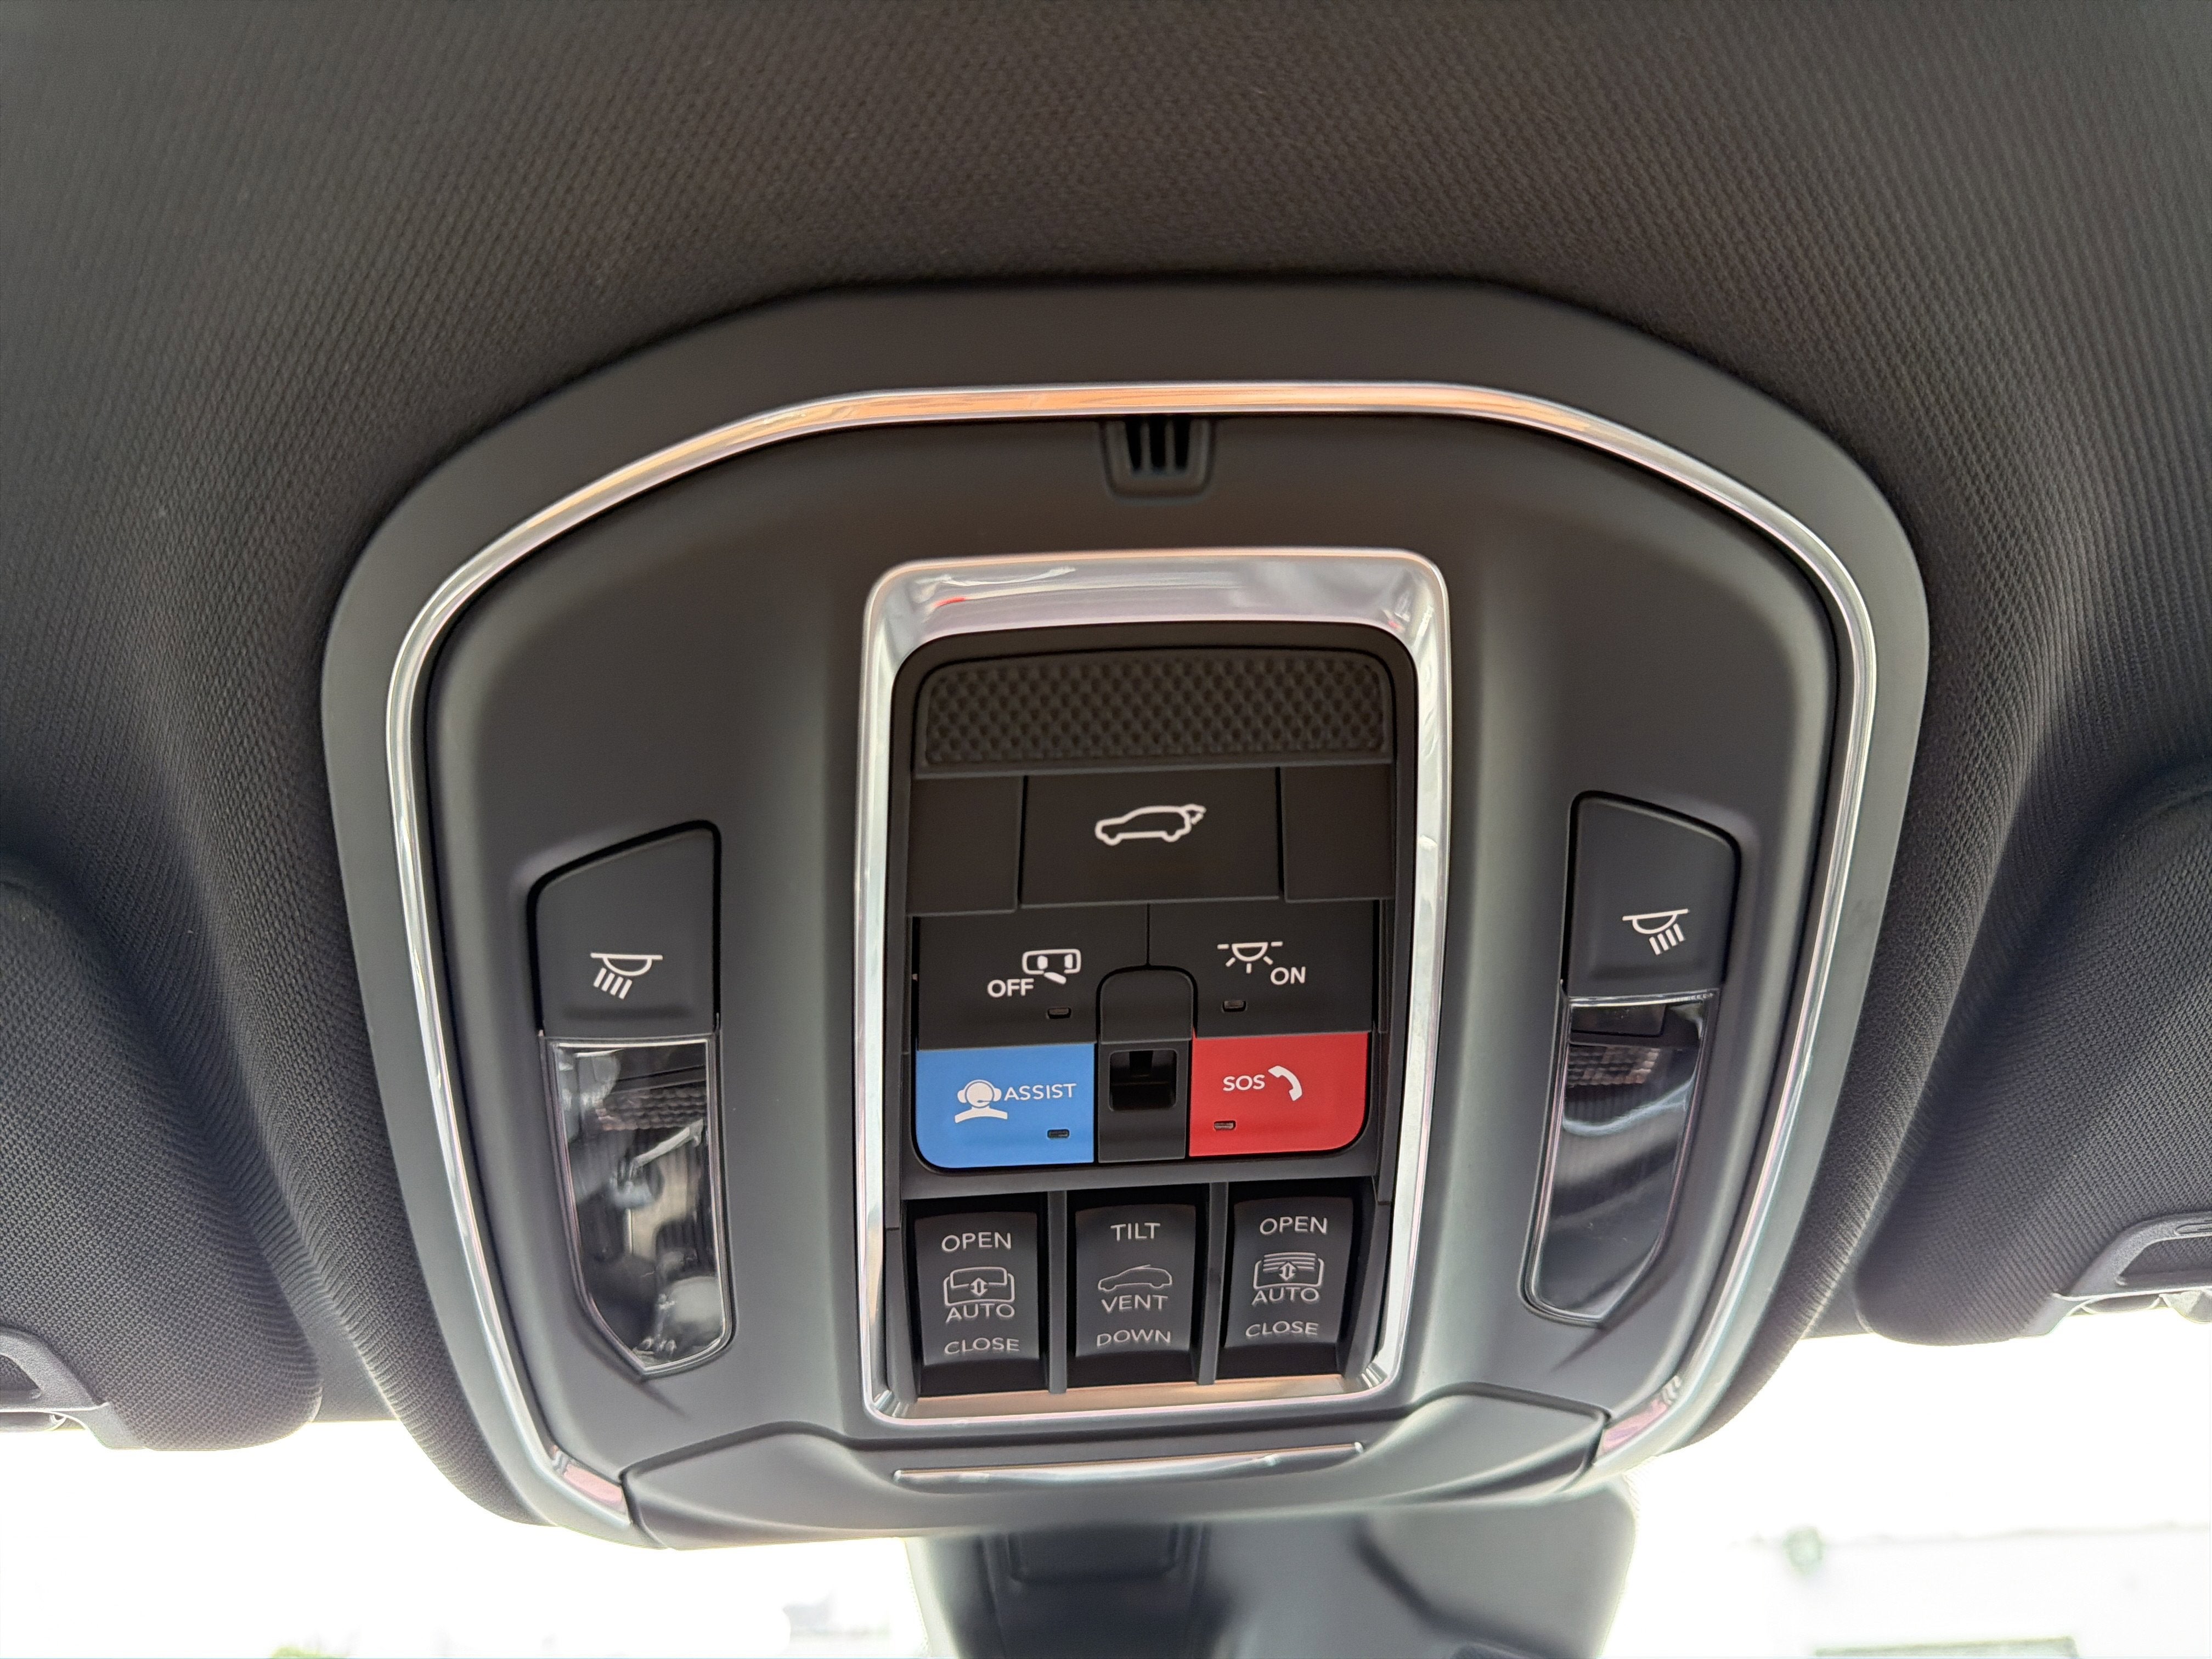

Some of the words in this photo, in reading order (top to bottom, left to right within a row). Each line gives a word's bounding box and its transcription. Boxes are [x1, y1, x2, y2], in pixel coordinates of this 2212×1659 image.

[1270, 967, 1306, 985] ON
[988, 978, 1034, 997] OFF
[1004, 1083, 1077, 1101] ASSIST
[1222, 1074, 1266, 1092] SOS
[1110, 1222, 1161, 1242] TILT
[1259, 1216, 1328, 1235] OPEN
[941, 1231, 1012, 1252] OPEN
[1101, 1295, 1169, 1313] VENT
[1251, 1286, 1320, 1306] AUTO
[945, 1304, 1015, 1323] AUTO
[1097, 1328, 1172, 1348] DOWN
[1245, 1321, 1319, 1339] CLOSE
[944, 1337, 1020, 1356] CLOSE
